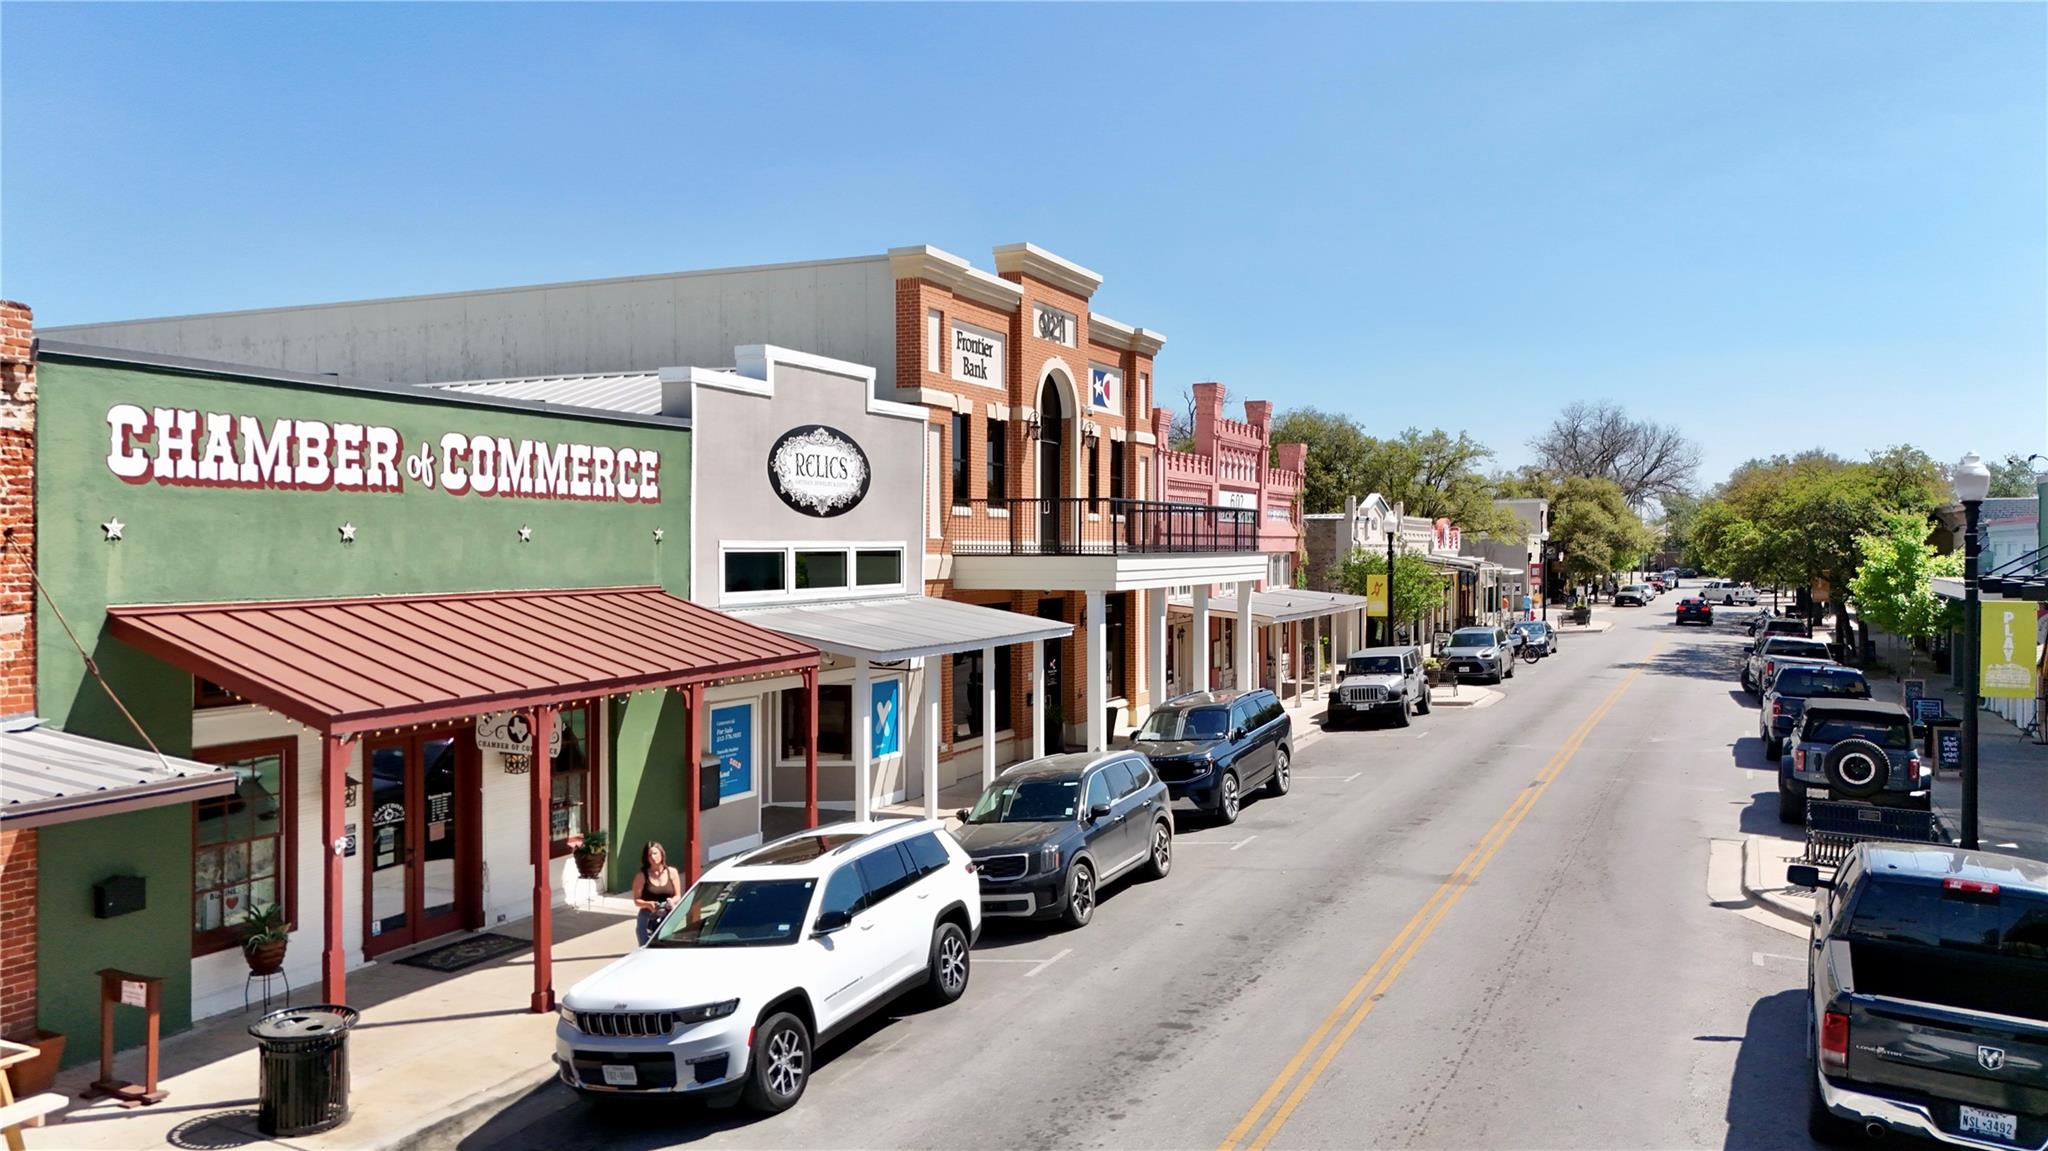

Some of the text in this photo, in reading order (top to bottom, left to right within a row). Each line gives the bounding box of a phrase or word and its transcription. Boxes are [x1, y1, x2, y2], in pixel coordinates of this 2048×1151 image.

[956, 330, 993, 358] Frontier
[963, 356, 987, 380] Bank
[106, 404, 661, 503] CHAMBER of COMMERCE
[795, 452, 848, 480] RELICS
[478, 740, 509, 750] CHAMBER
[1977, 1110, 1999, 1119] TEXAS
